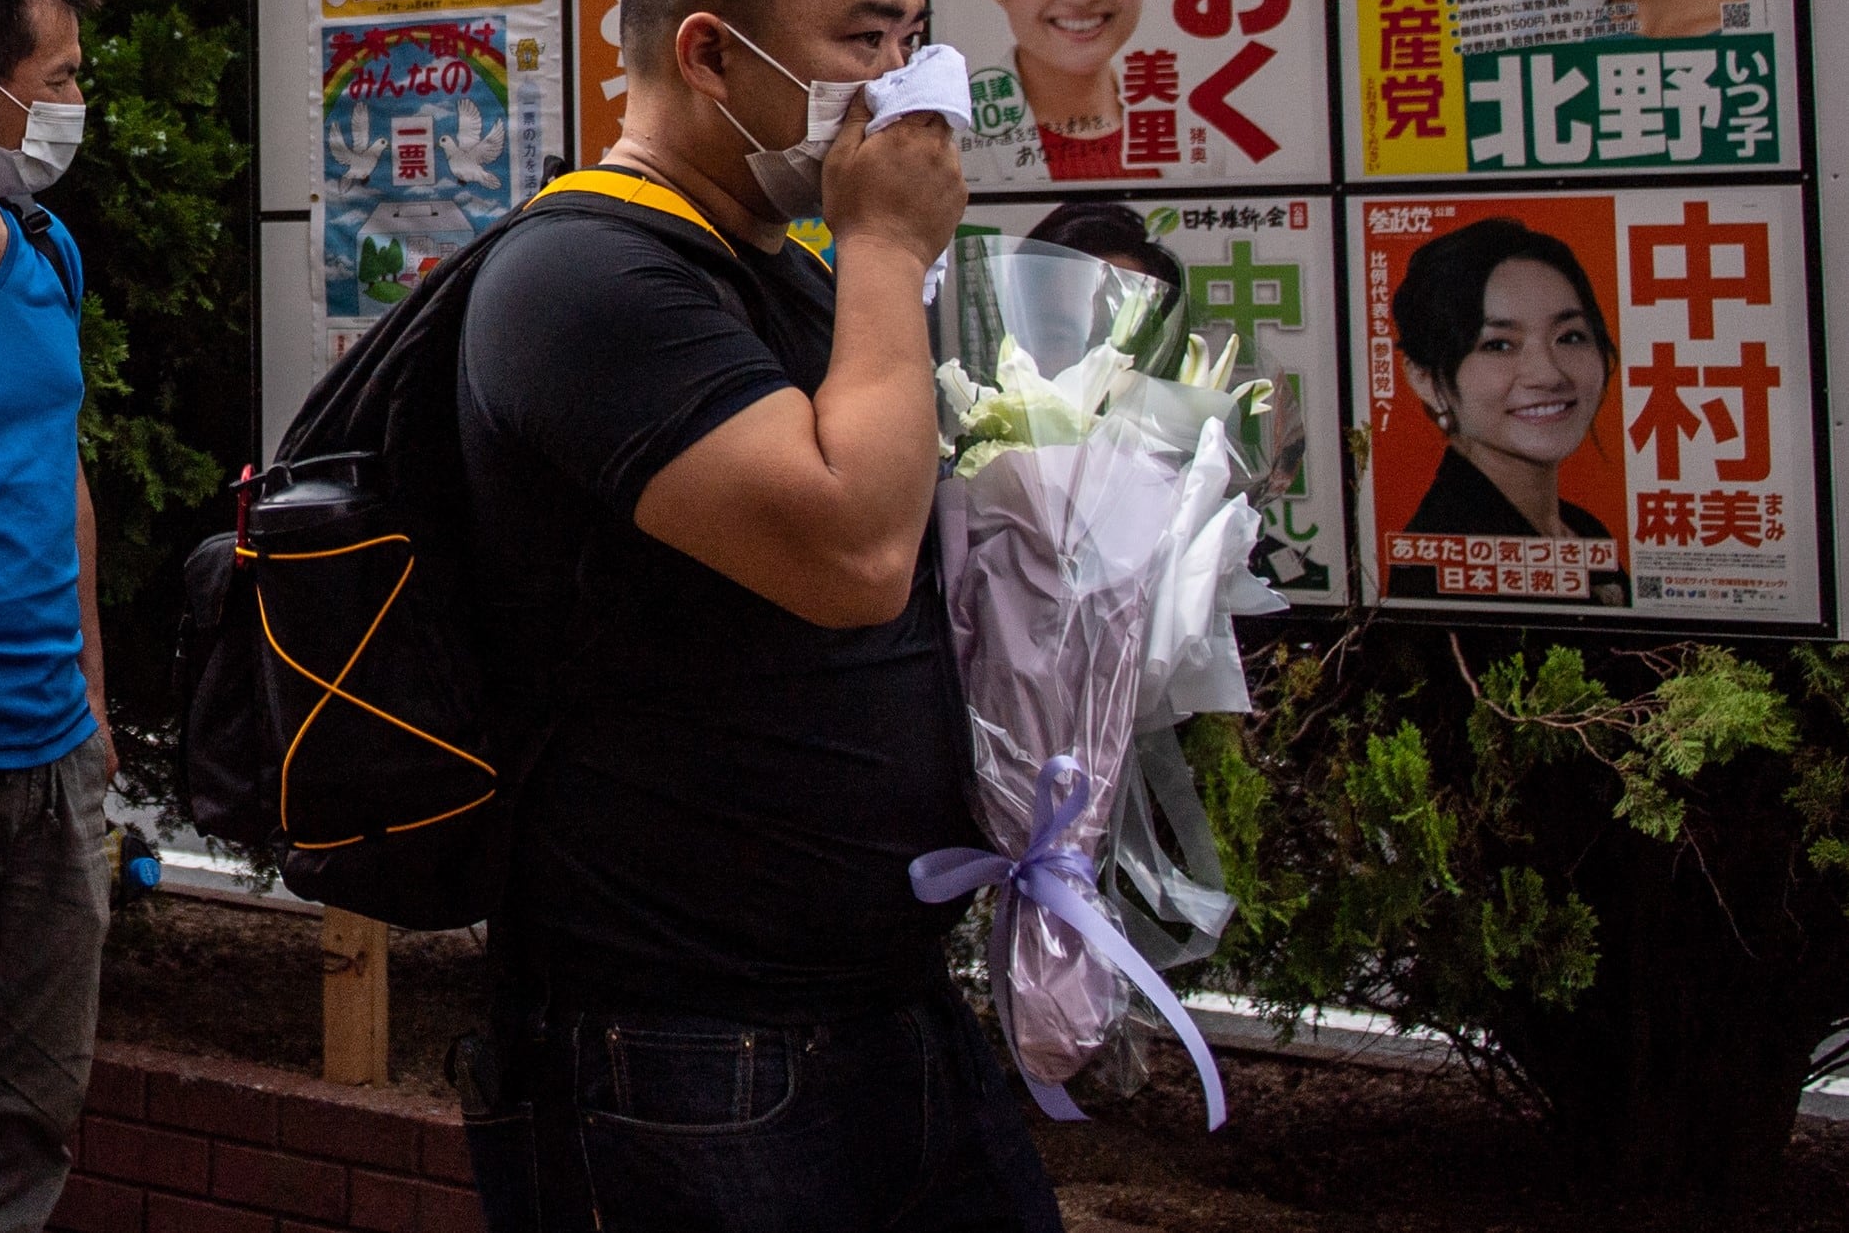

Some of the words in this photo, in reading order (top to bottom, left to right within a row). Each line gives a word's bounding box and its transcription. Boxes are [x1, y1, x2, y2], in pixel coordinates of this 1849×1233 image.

[329, 23, 496, 64] 未来へ届け
[349, 61, 473, 99] みんなの
[1123, 49, 1182, 166] 美里
[1469, 49, 1723, 167] 北野
[1725, 49, 1773, 159] いつ子
[396, 127, 430, 180] 一票
[1368, 205, 1434, 234] 参政党
[1627, 201, 1781, 482] 中村
[1635, 490, 1763, 548] 麻美
[1764, 493, 1785, 542] まみ
[1391, 536, 1615, 568] あなたの気づきが
[1442, 567, 1584, 593] 日本を救う
